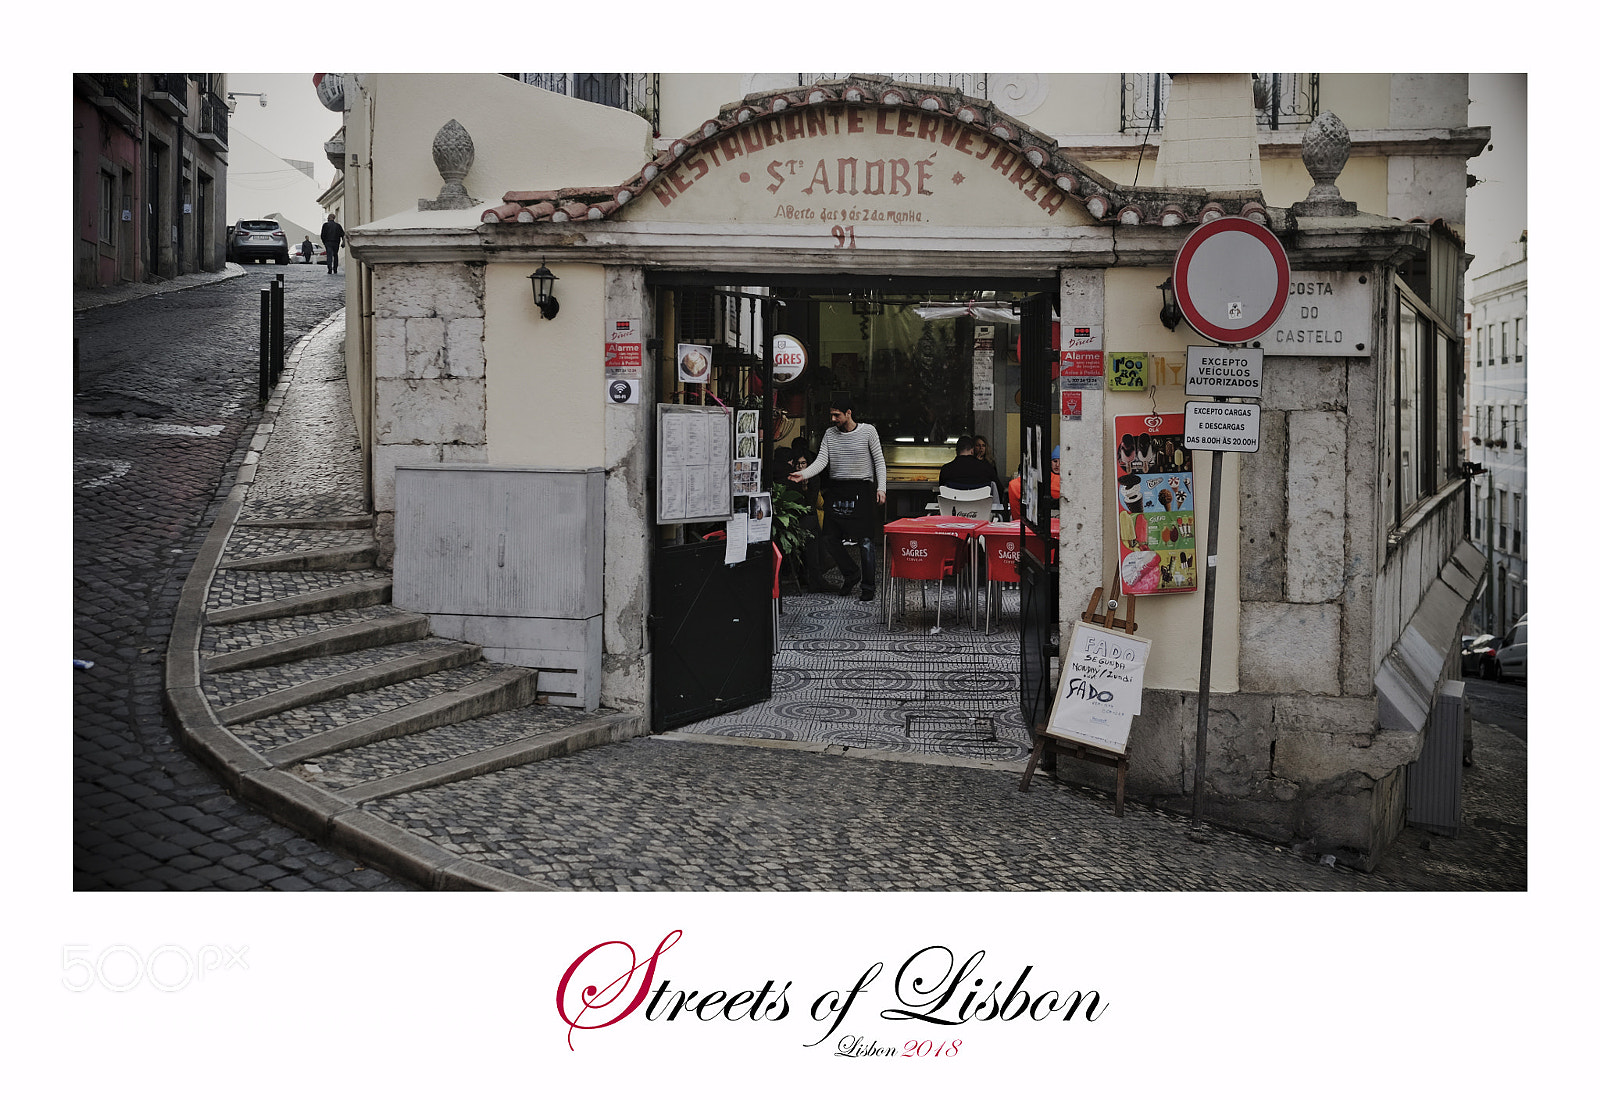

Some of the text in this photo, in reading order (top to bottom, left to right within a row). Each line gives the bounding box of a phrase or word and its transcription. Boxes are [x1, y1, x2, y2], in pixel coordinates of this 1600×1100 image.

[651, 106, 1066, 216] RESTAURANTE CERVEJARIA
[801, 151, 937, 197] ANDRÉ
[820, 207, 838, 222] das
[841, 208, 848, 221] 9
[862, 208, 870, 221] 2
[831, 225, 856, 249] 91
[1290, 283, 1333, 295] COSTA
[1301, 306, 1319, 319] DO
[1276, 330, 1343, 343] CASTELO
[608, 344, 640, 352] Alarme
[774, 353, 802, 365] GRES
[1064, 352, 1100, 360] Alarme
[1201, 357, 1248, 367] EXCEPTO
[1198, 366, 1250, 377] VEÍCULOS
[1188, 377, 1259, 388] AUTORIZADOS
[1193, 407, 1252, 416] EXCEPTO CARGAS
[1205, 423, 1245, 431] DESCARGAS
[1201, 436, 1220, 444] 8.00H
[1232, 438, 1257, 446] 20.00H
[901, 547, 928, 557] SAGRES
[998, 549, 1021, 560] SAGRE
[1065, 678, 1114, 702] FADO
